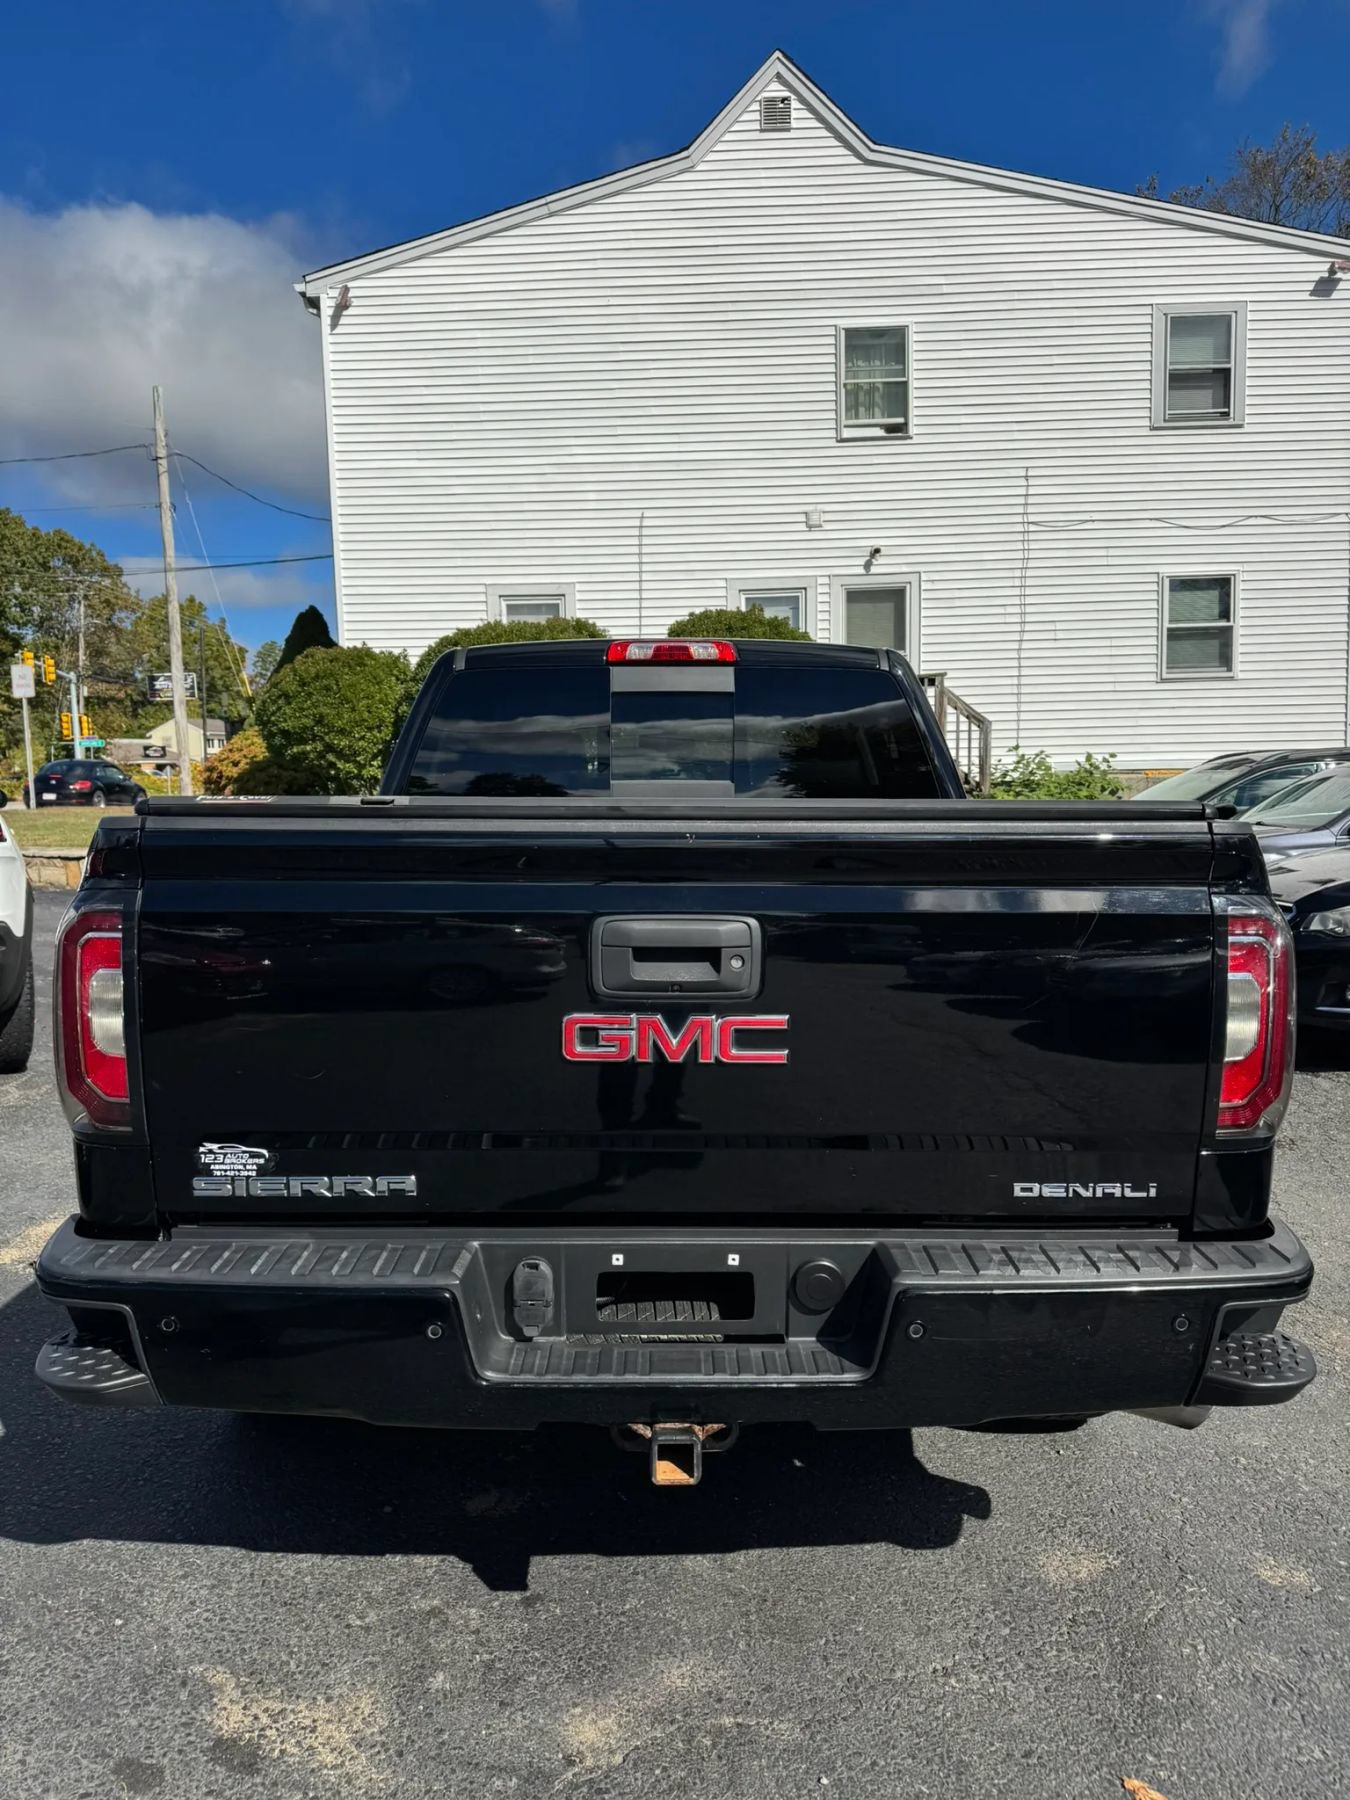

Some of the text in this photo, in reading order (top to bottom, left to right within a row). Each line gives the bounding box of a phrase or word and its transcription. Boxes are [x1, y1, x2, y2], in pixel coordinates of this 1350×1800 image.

[562, 1013, 790, 1064] GMC
[200, 1154, 224, 1163] 123
[192, 1175, 417, 1198] SIERRA
[1013, 1182, 1158, 1198] DENALI
